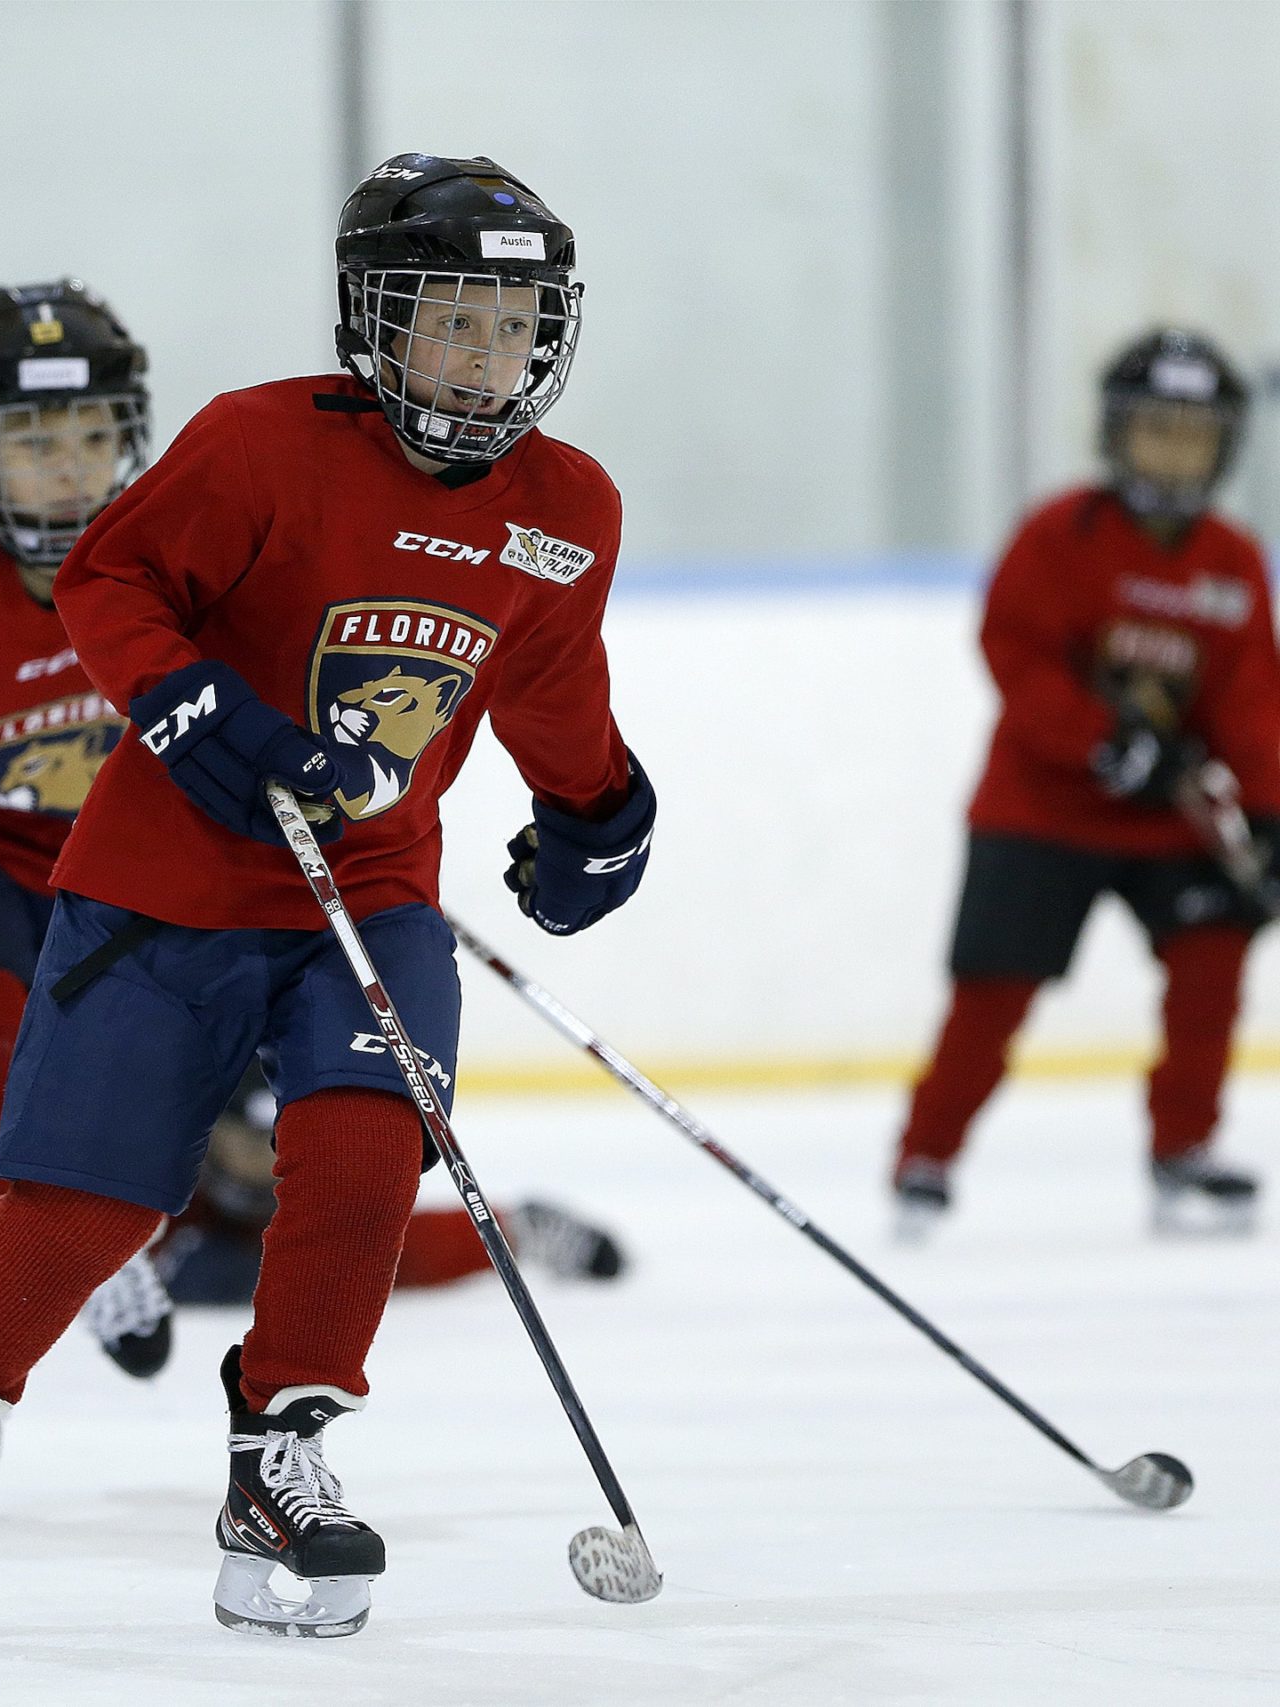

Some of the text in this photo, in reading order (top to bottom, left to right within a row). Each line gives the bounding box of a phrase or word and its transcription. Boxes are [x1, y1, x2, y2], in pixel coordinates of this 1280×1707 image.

[500, 236, 532, 247] Austin
[393, 531, 491, 565] CCM
[540, 540, 589, 566] LEARN
[543, 558, 580, 579] PLAY
[339, 614, 488, 664] FLORIDA
[139, 683, 217, 756] CM
[324, 898, 341, 914] 88
[372, 1003, 436, 1113] JETSPEED
[470, 1201, 490, 1223] FLEX
[248, 1504, 279, 1540] CCM
